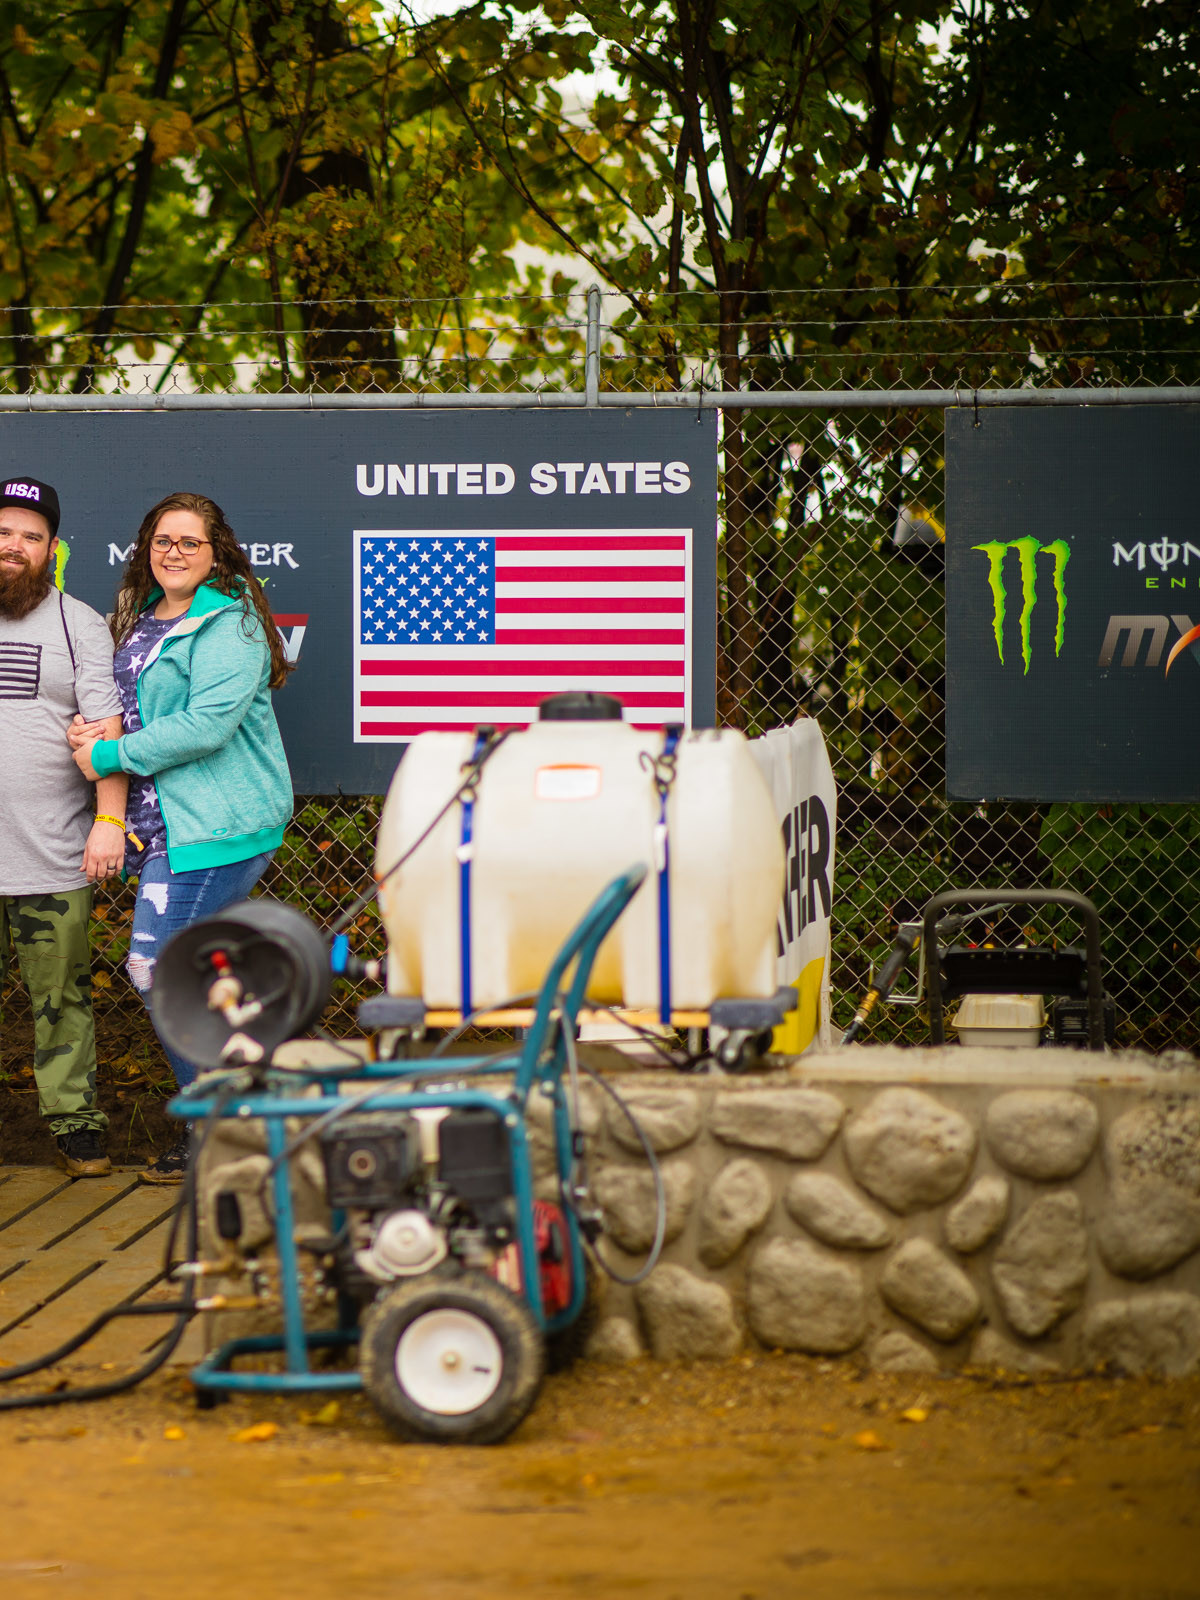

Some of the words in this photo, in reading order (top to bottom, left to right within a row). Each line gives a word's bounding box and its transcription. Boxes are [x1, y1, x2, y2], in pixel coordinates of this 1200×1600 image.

[356, 463, 516, 496] UNITED
[529, 461, 692, 495] STATES
[4, 483, 40, 501] USA
